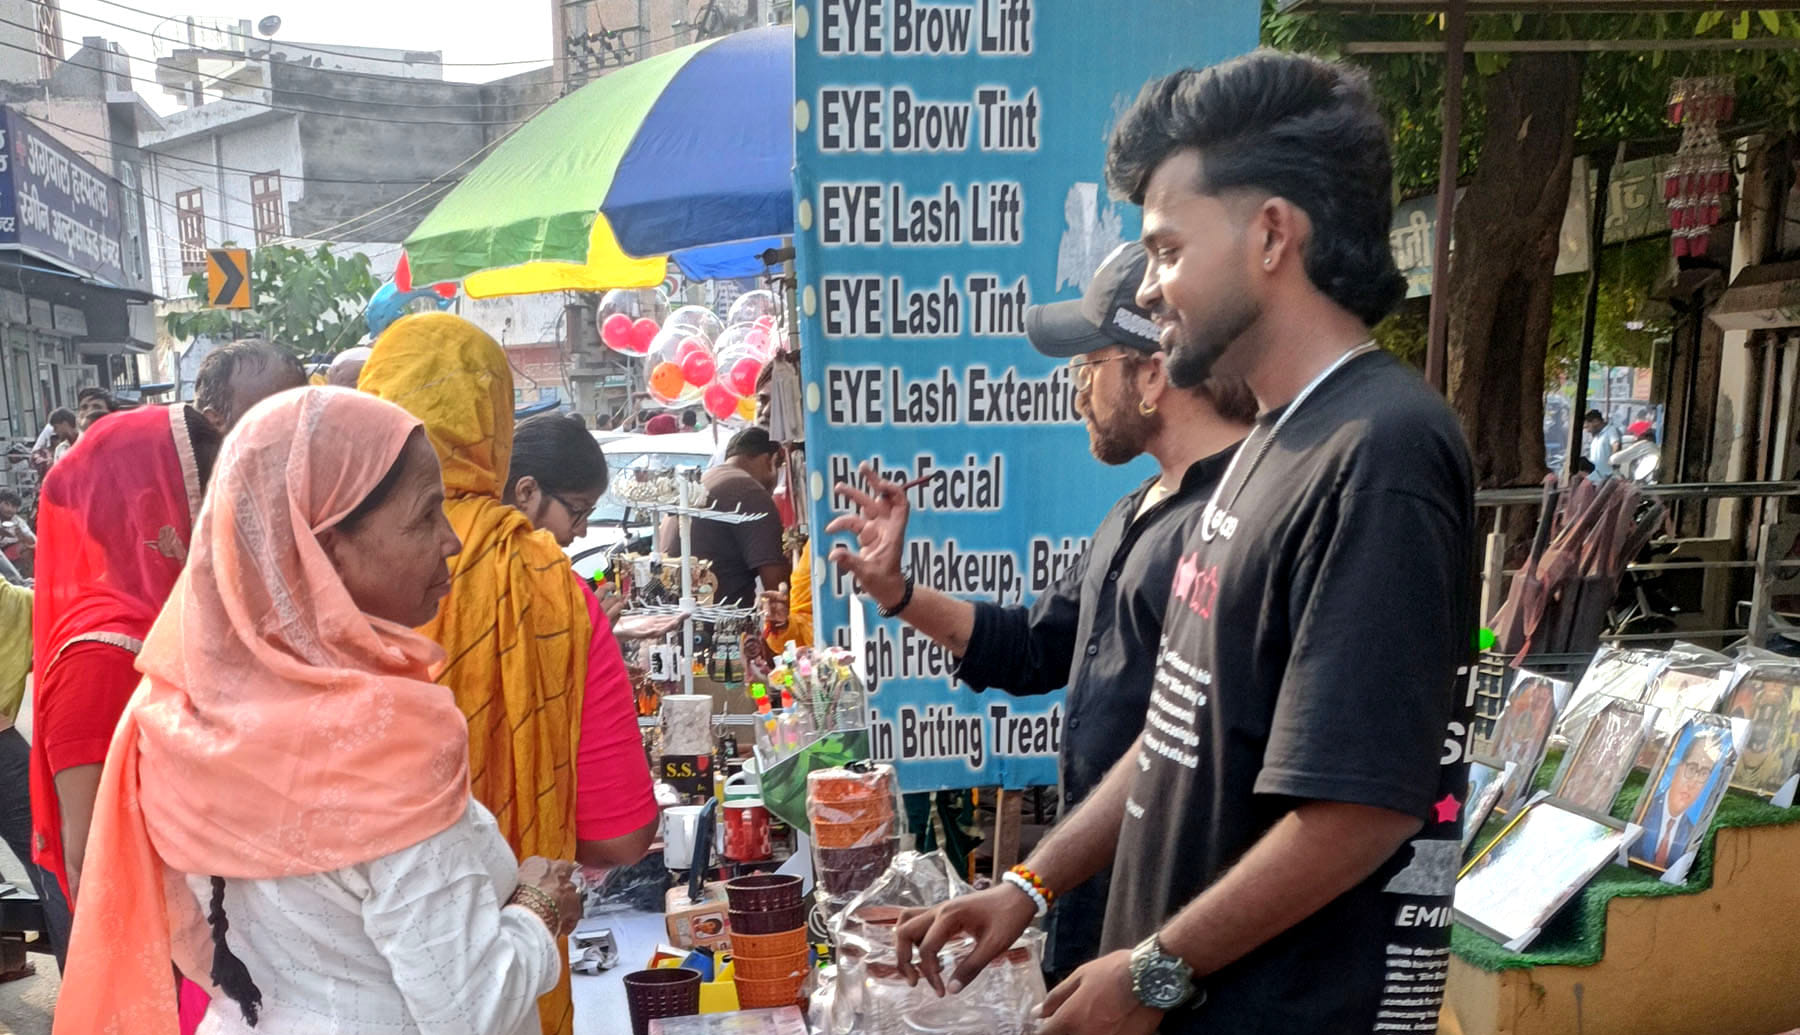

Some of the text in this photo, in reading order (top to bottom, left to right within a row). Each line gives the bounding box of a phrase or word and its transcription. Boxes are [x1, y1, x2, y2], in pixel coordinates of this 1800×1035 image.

[822, 0, 1030, 52] EYE Brow Lift
[821, 87, 1037, 149] EYE Brow Tint
[822, 183, 1020, 243] EYE Lash Lift
[825, 277, 1026, 335] EYE Lash Tint
[829, 369, 882, 424] EYE
[892, 369, 957, 423] Lash
[917, 456, 1001, 509] Facial
[912, 541, 1022, 602] Makeup,
[902, 706, 983, 768] Briting
[990, 704, 1060, 755] Treat
[666, 762, 697, 777] S.S.
